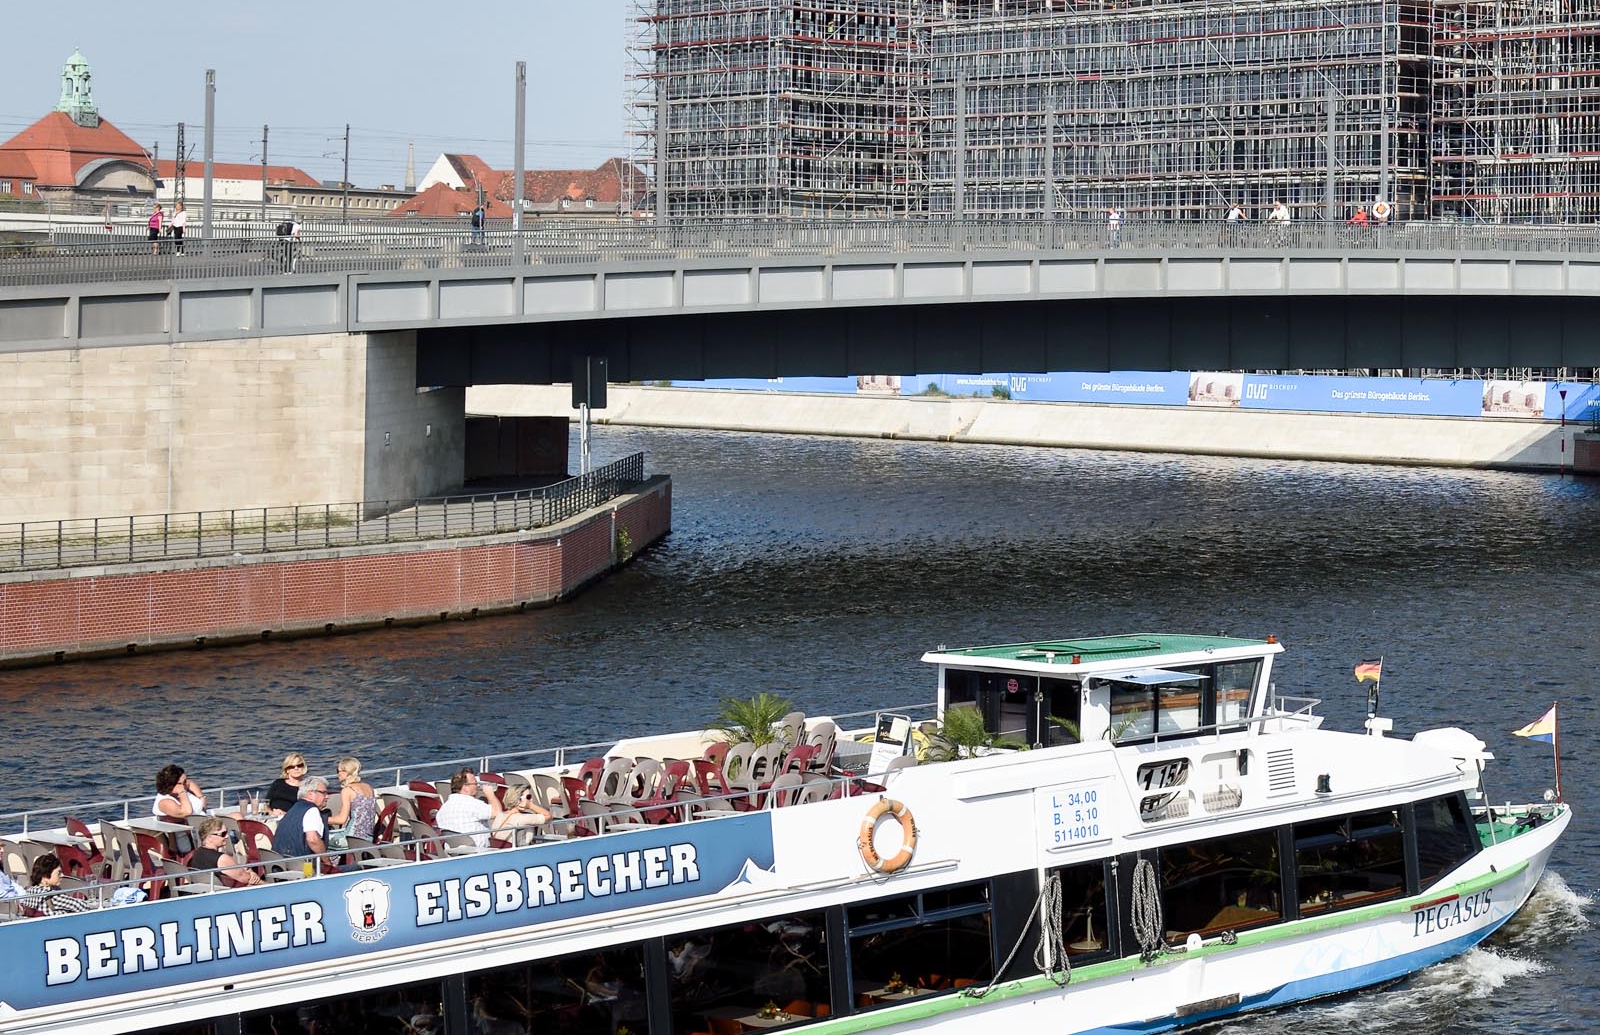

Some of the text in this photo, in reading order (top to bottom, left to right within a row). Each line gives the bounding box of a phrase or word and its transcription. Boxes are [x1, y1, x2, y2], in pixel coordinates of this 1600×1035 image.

[1246, 383, 1268, 400] OVG
[1331, 389, 1344, 399] Das
[1344, 390, 1367, 401] grünste
[1367, 390, 1407, 402] Bürogebäude
[1052, 796, 1063, 808] L.
[1054, 813, 1064, 825] B.
[1054, 824, 1099, 842] 5114010
[44, 842, 701, 987] BERLINER EISBRECHER
[1412, 888, 1493, 938] PEGASUS
[352, 926, 388, 942] BERLIN
